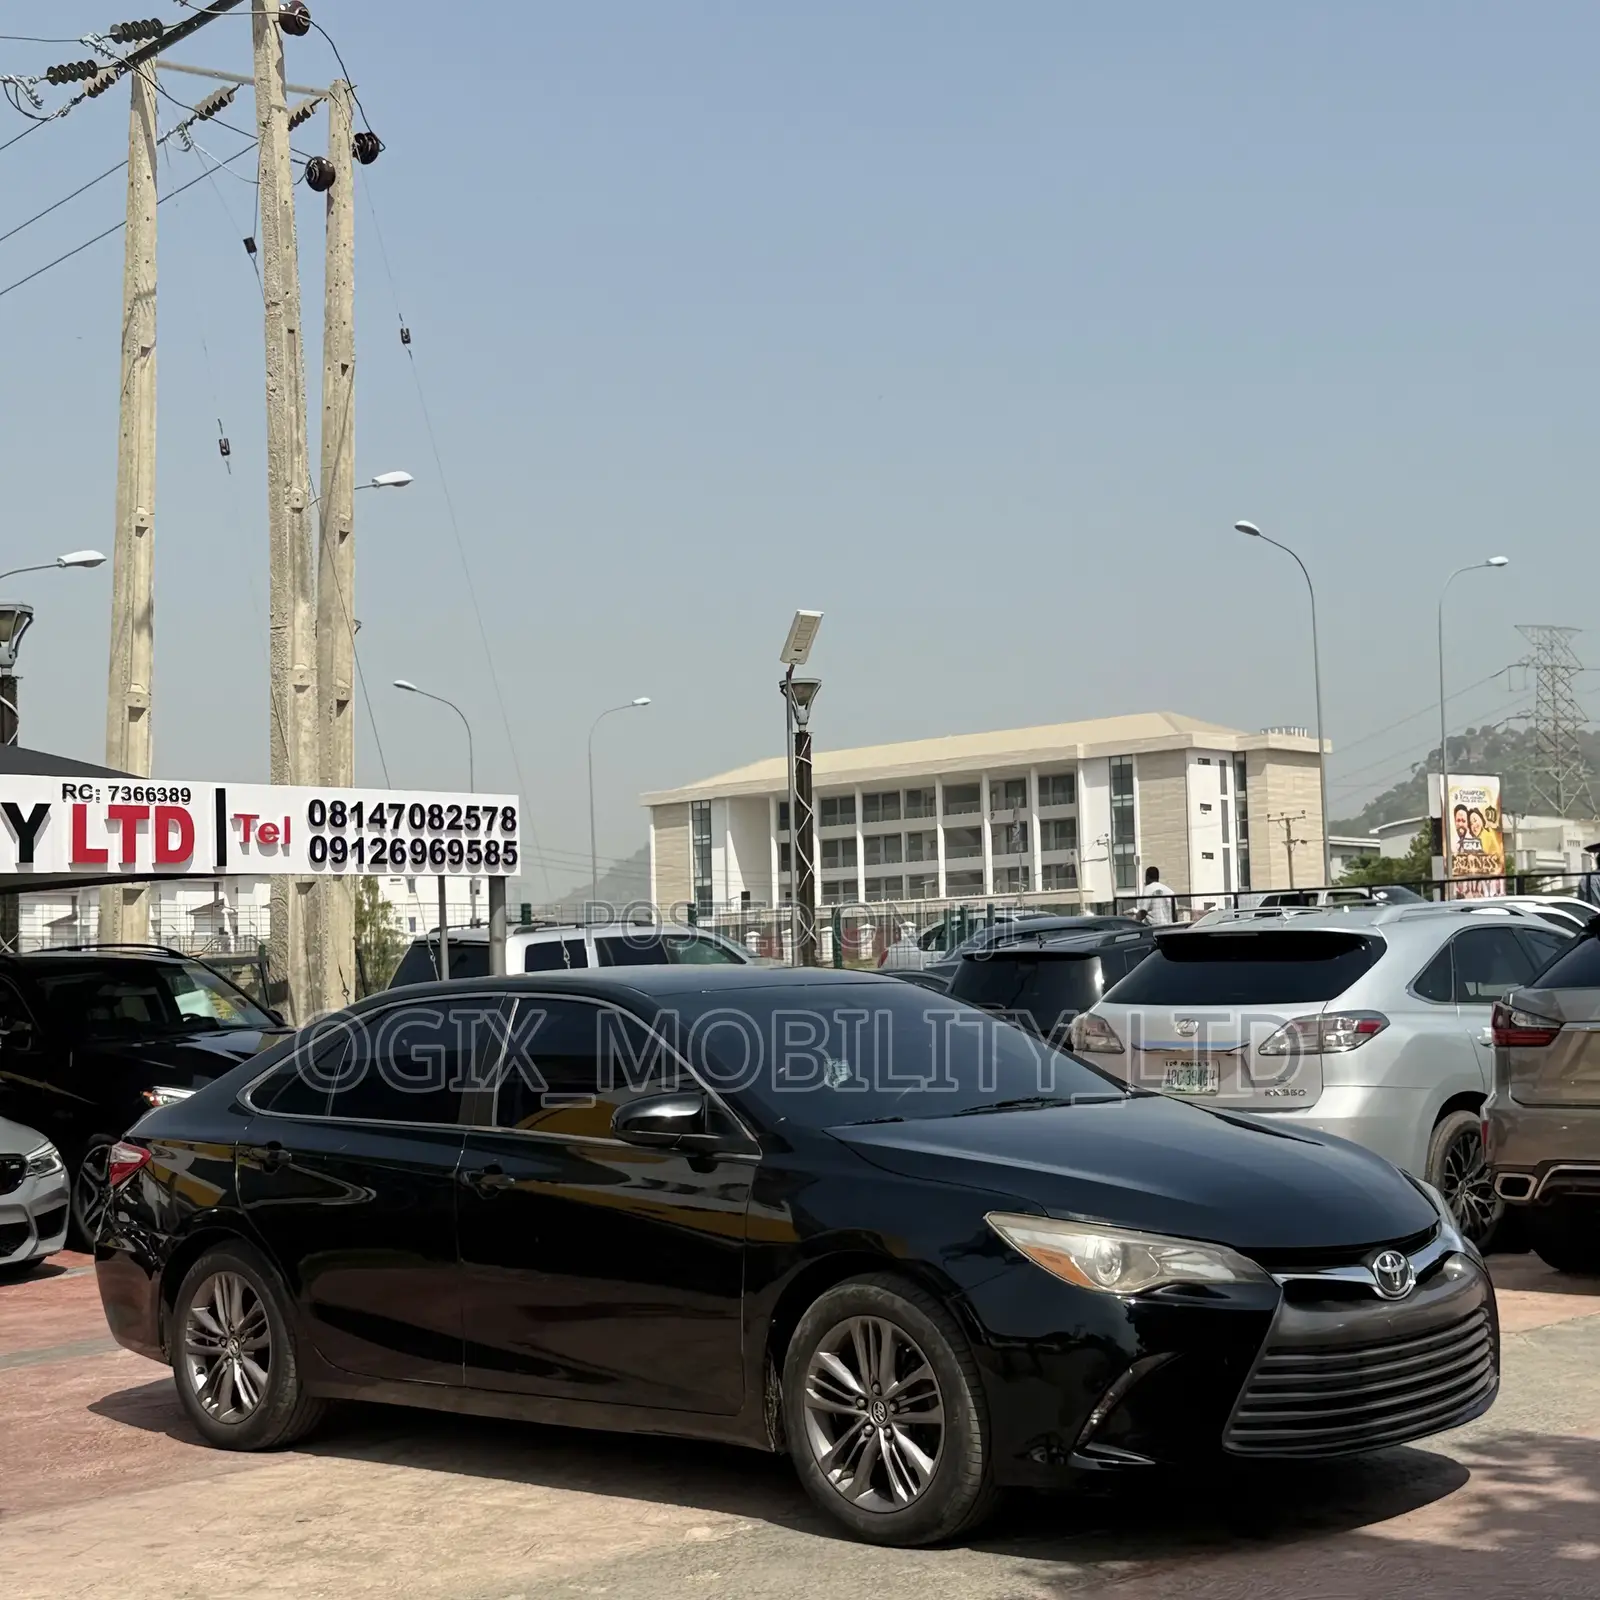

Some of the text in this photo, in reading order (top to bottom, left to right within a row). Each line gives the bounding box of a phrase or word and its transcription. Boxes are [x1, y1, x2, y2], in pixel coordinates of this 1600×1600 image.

[61, 783, 192, 804] RC: 7366389
[234, 813, 290, 845] Tel
[308, 799, 517, 832] 08147082578
[71, 804, 195, 864] LTD
[309, 835, 518, 866] 09126969585
